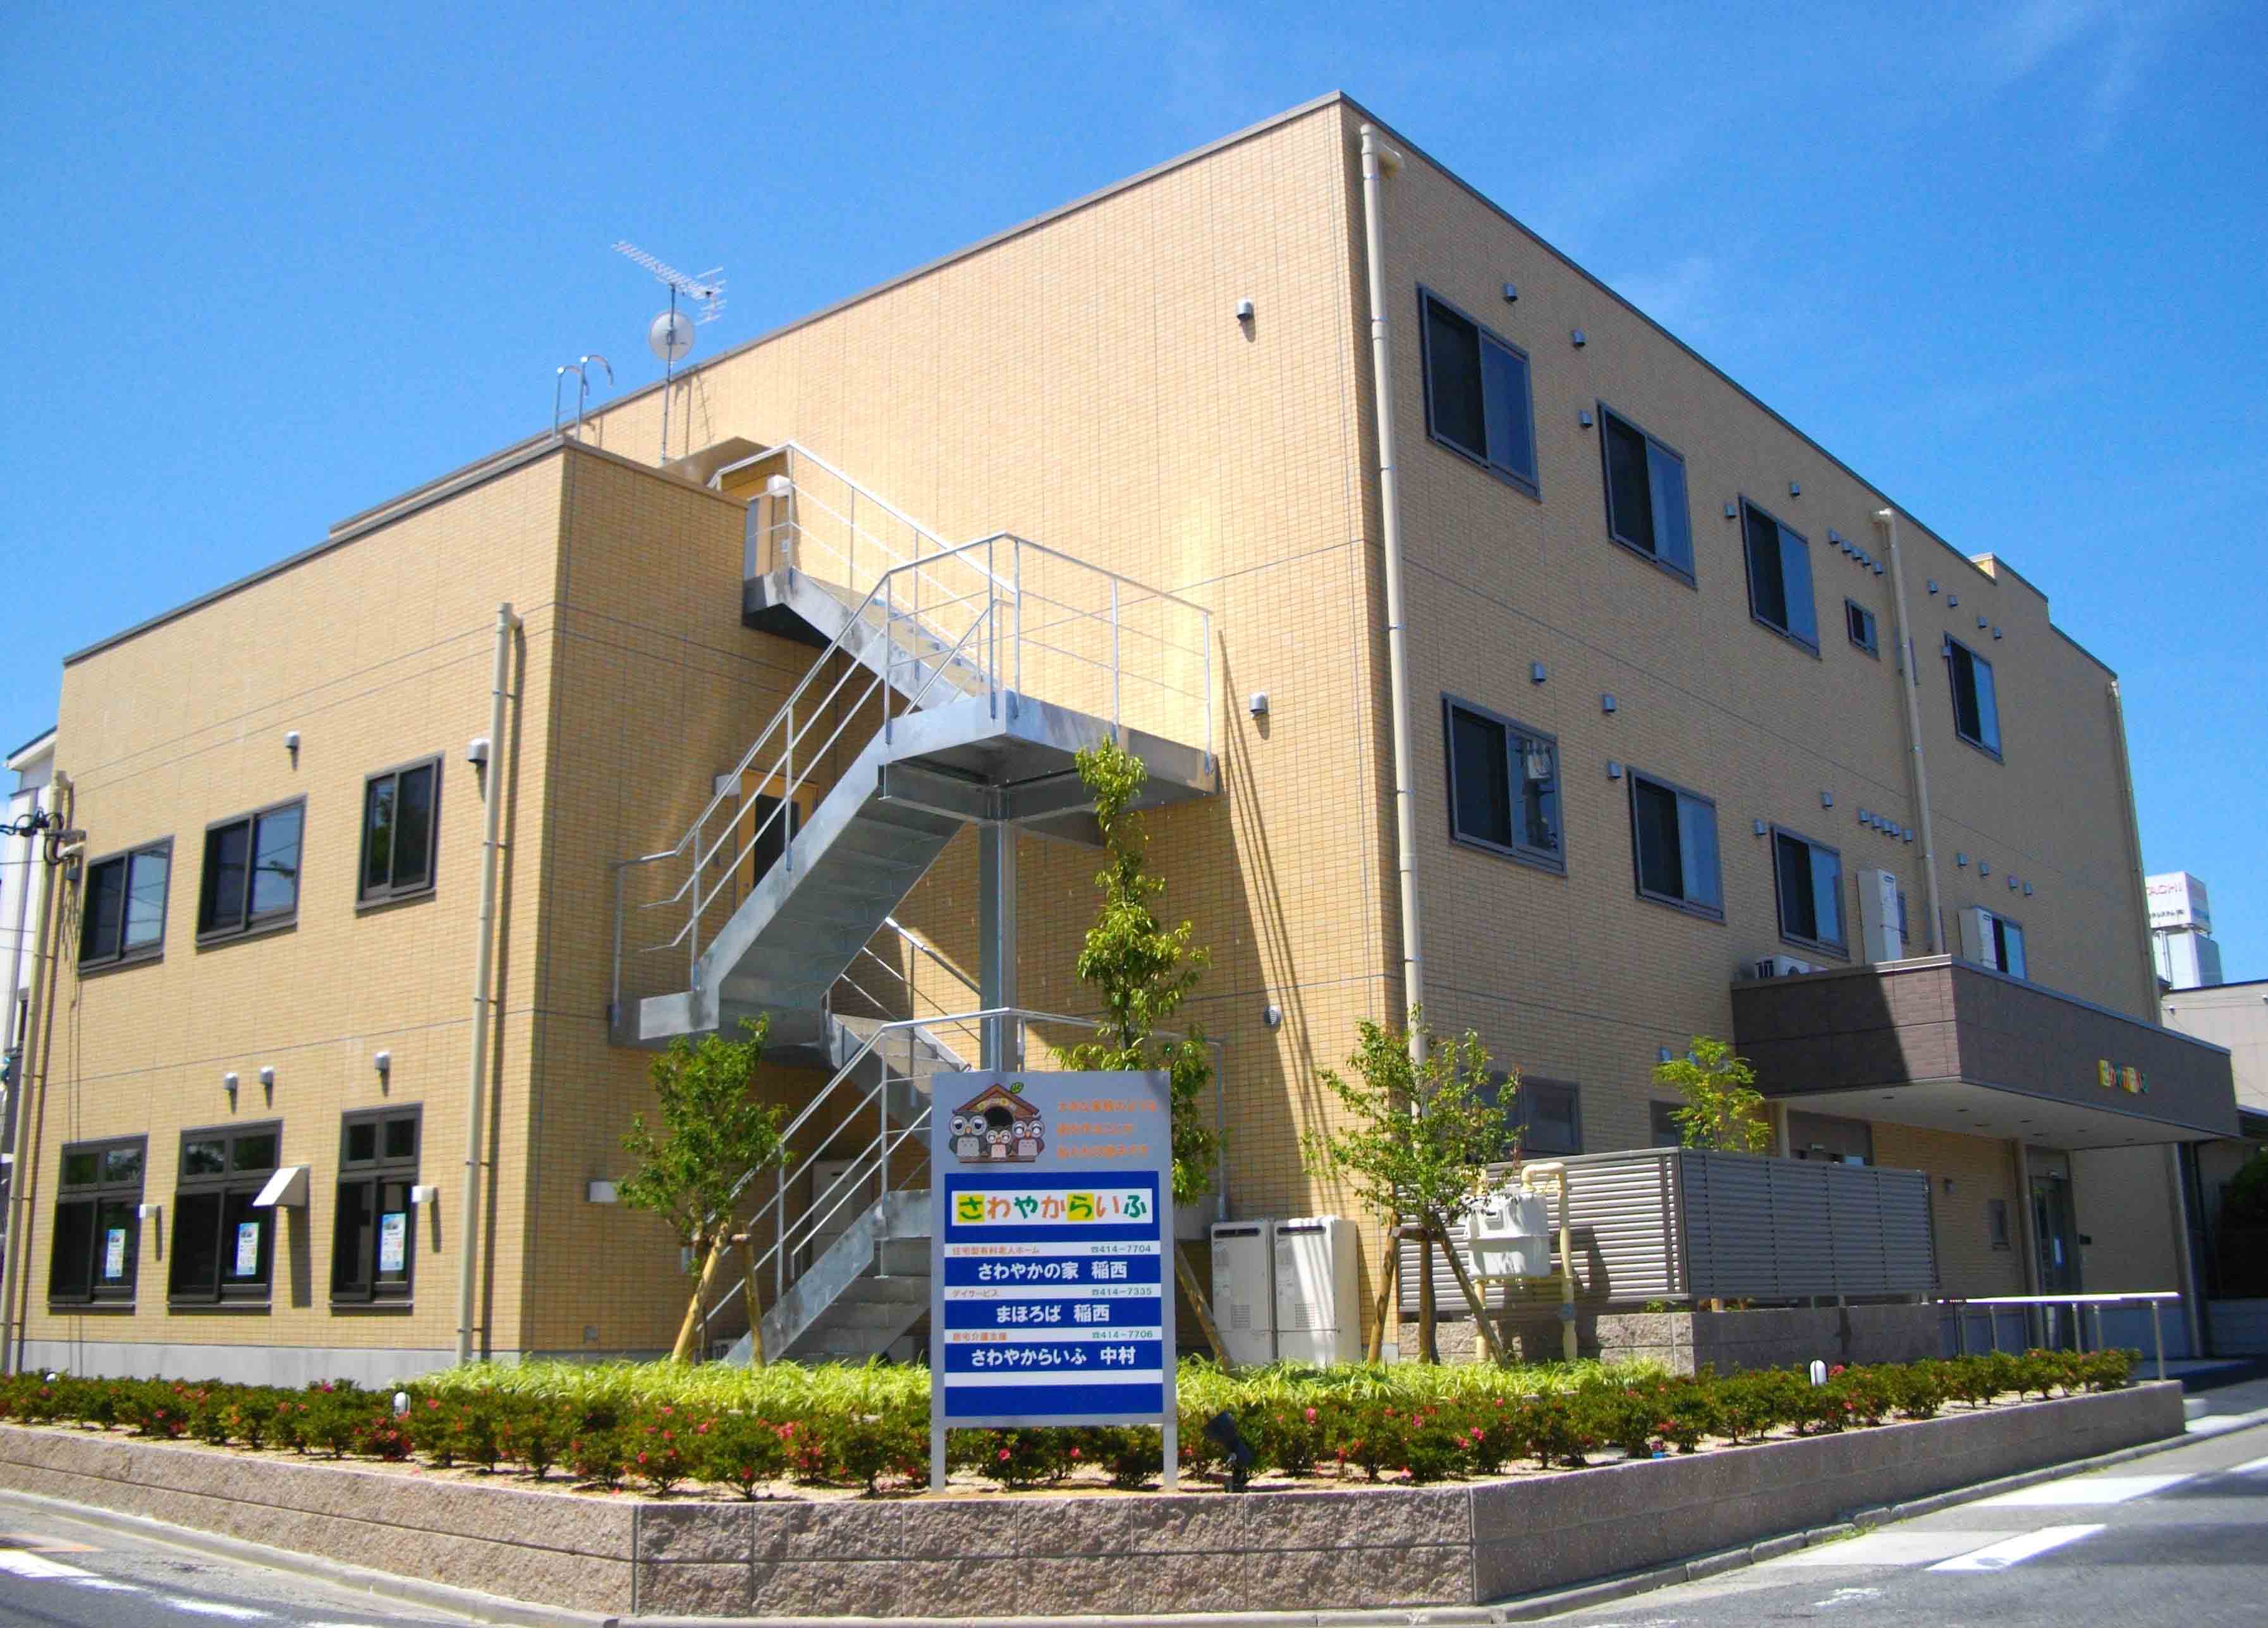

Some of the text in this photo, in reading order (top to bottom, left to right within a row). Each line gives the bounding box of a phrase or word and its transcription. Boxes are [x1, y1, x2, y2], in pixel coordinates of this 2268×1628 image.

[959, 1194, 1147, 1220] さわやからいふ
[978, 1261, 1128, 1280] さわやかの家 稲西
[996, 1304, 1110, 1323] まほろば 稲西
[971, 1346, 1136, 1366] さわやからいふ 中村
